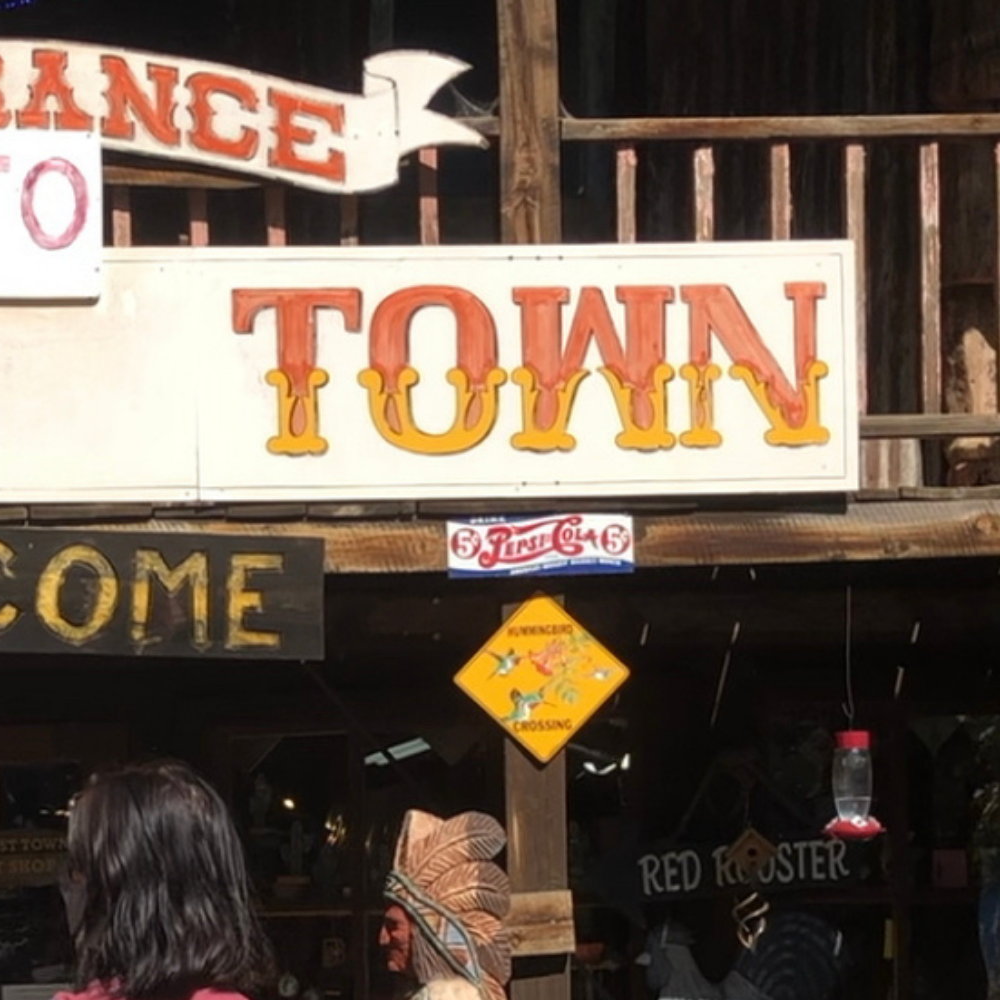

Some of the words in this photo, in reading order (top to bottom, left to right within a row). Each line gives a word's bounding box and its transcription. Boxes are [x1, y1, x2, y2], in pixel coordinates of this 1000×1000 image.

[232, 281, 830, 456] TOWN
[513, 718, 572, 732] CROSSING
[638, 849, 702, 896] RED
